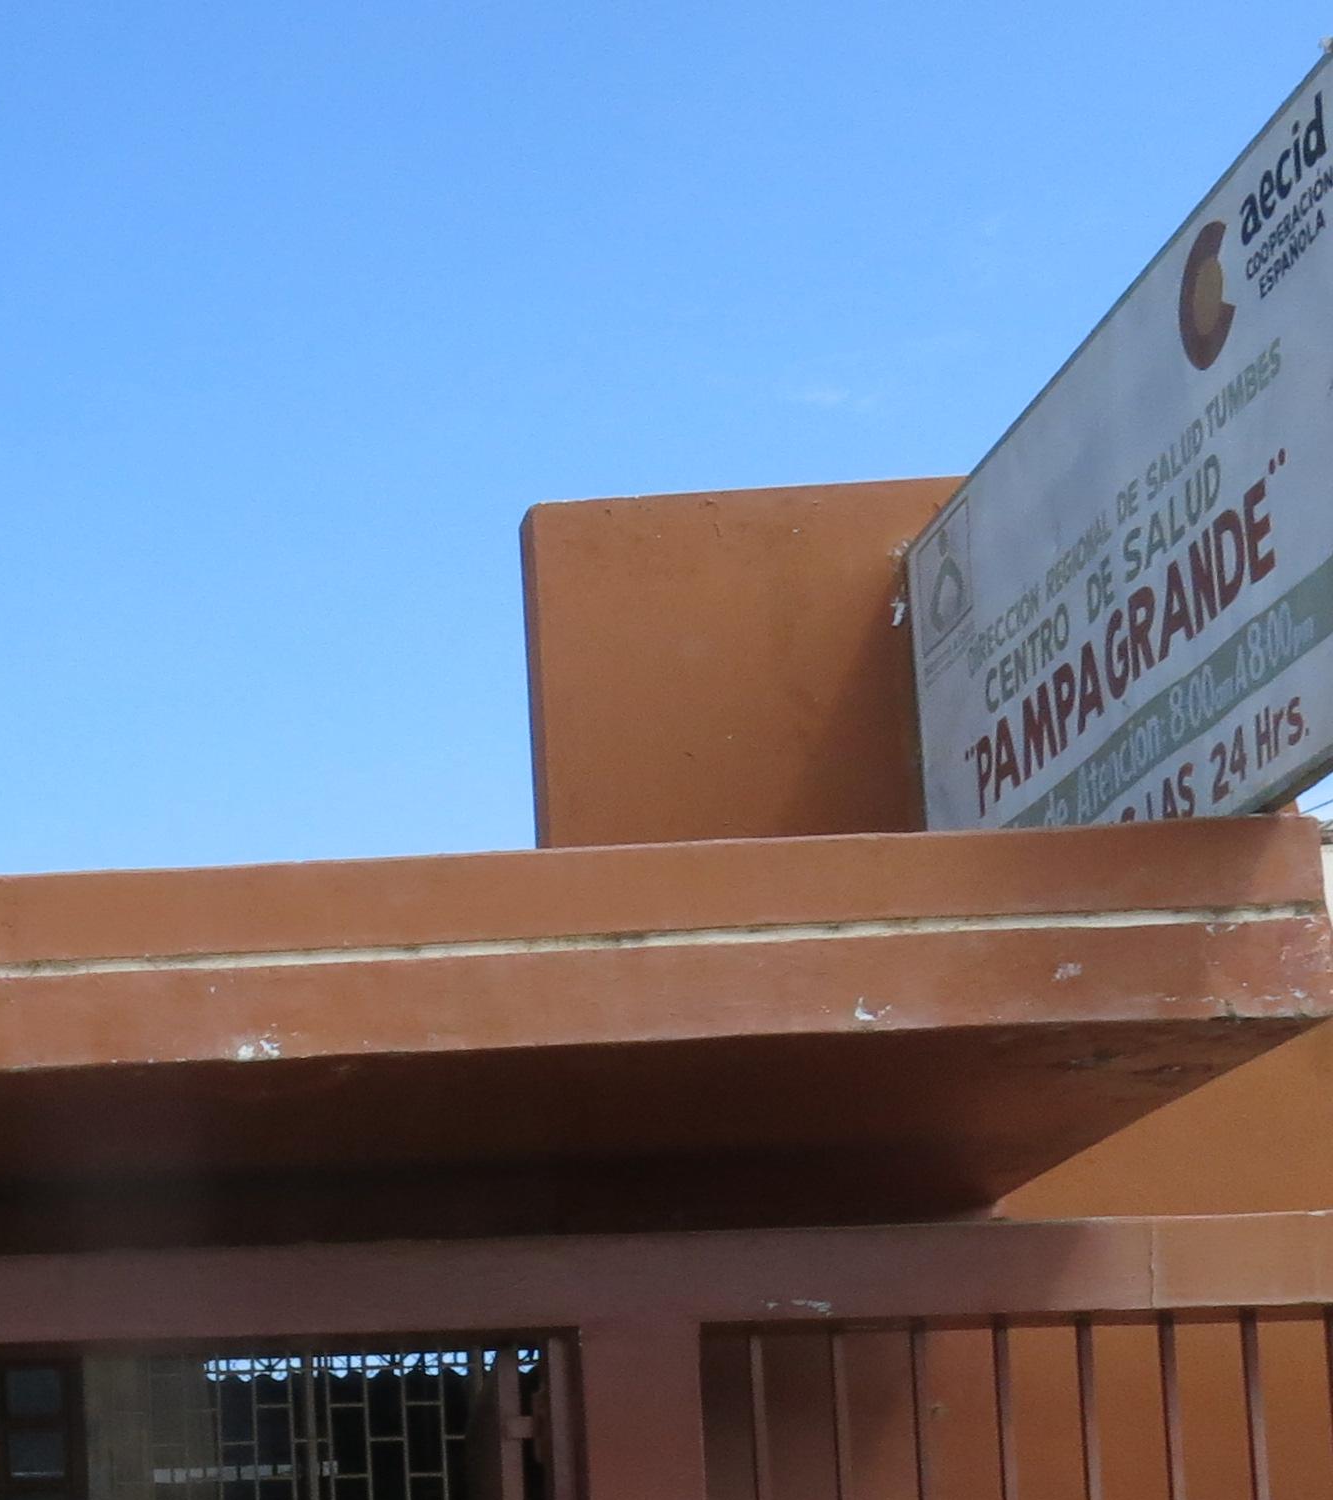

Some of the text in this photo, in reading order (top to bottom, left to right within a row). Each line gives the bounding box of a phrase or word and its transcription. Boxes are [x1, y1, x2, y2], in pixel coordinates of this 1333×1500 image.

[1240, 90, 1328, 246] aecid
[1258, 207, 1326, 300] ESPAÑOLA
[1116, 479, 1138, 526] DE
[1146, 418, 1204, 501] SALUD
[1205, 337, 1282, 438] TUMBES
[985, 602, 1070, 714] CENTRO
[1086, 556, 1115, 624] DE
[1123, 453, 1222, 584] SALUD
[1208, 725, 1248, 806] 24
